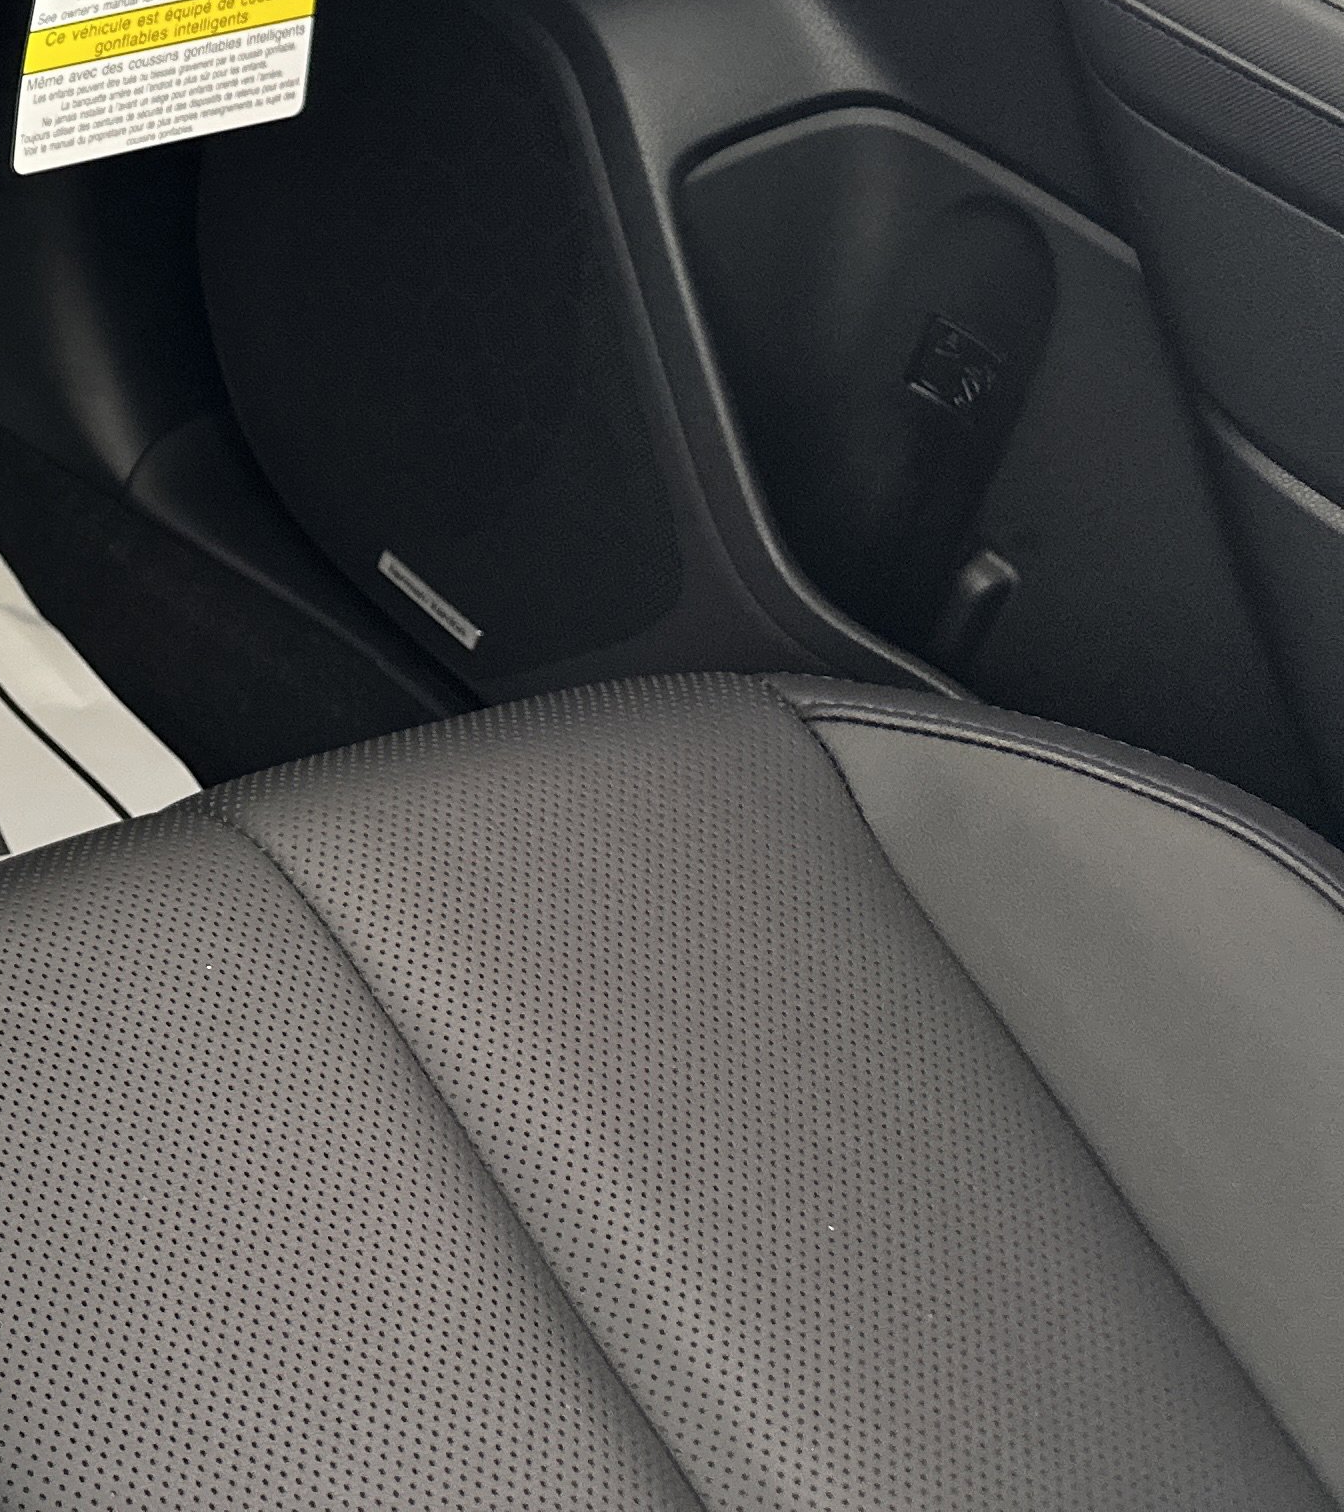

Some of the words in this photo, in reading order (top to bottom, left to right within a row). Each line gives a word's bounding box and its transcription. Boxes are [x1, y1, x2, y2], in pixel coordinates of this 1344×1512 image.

[38, 13, 57, 25] See
[45, 31, 66, 47] Ce
[137, 11, 159, 27] est
[95, 29, 168, 57] gonflables
[174, 12, 248, 36] intelligents
[68, 68, 97, 83] avec
[102, 62, 123, 76] des
[128, 51, 179, 70] coussins
[184, 38, 241, 62] gonflables
[247, 25, 305, 46] intelligents
